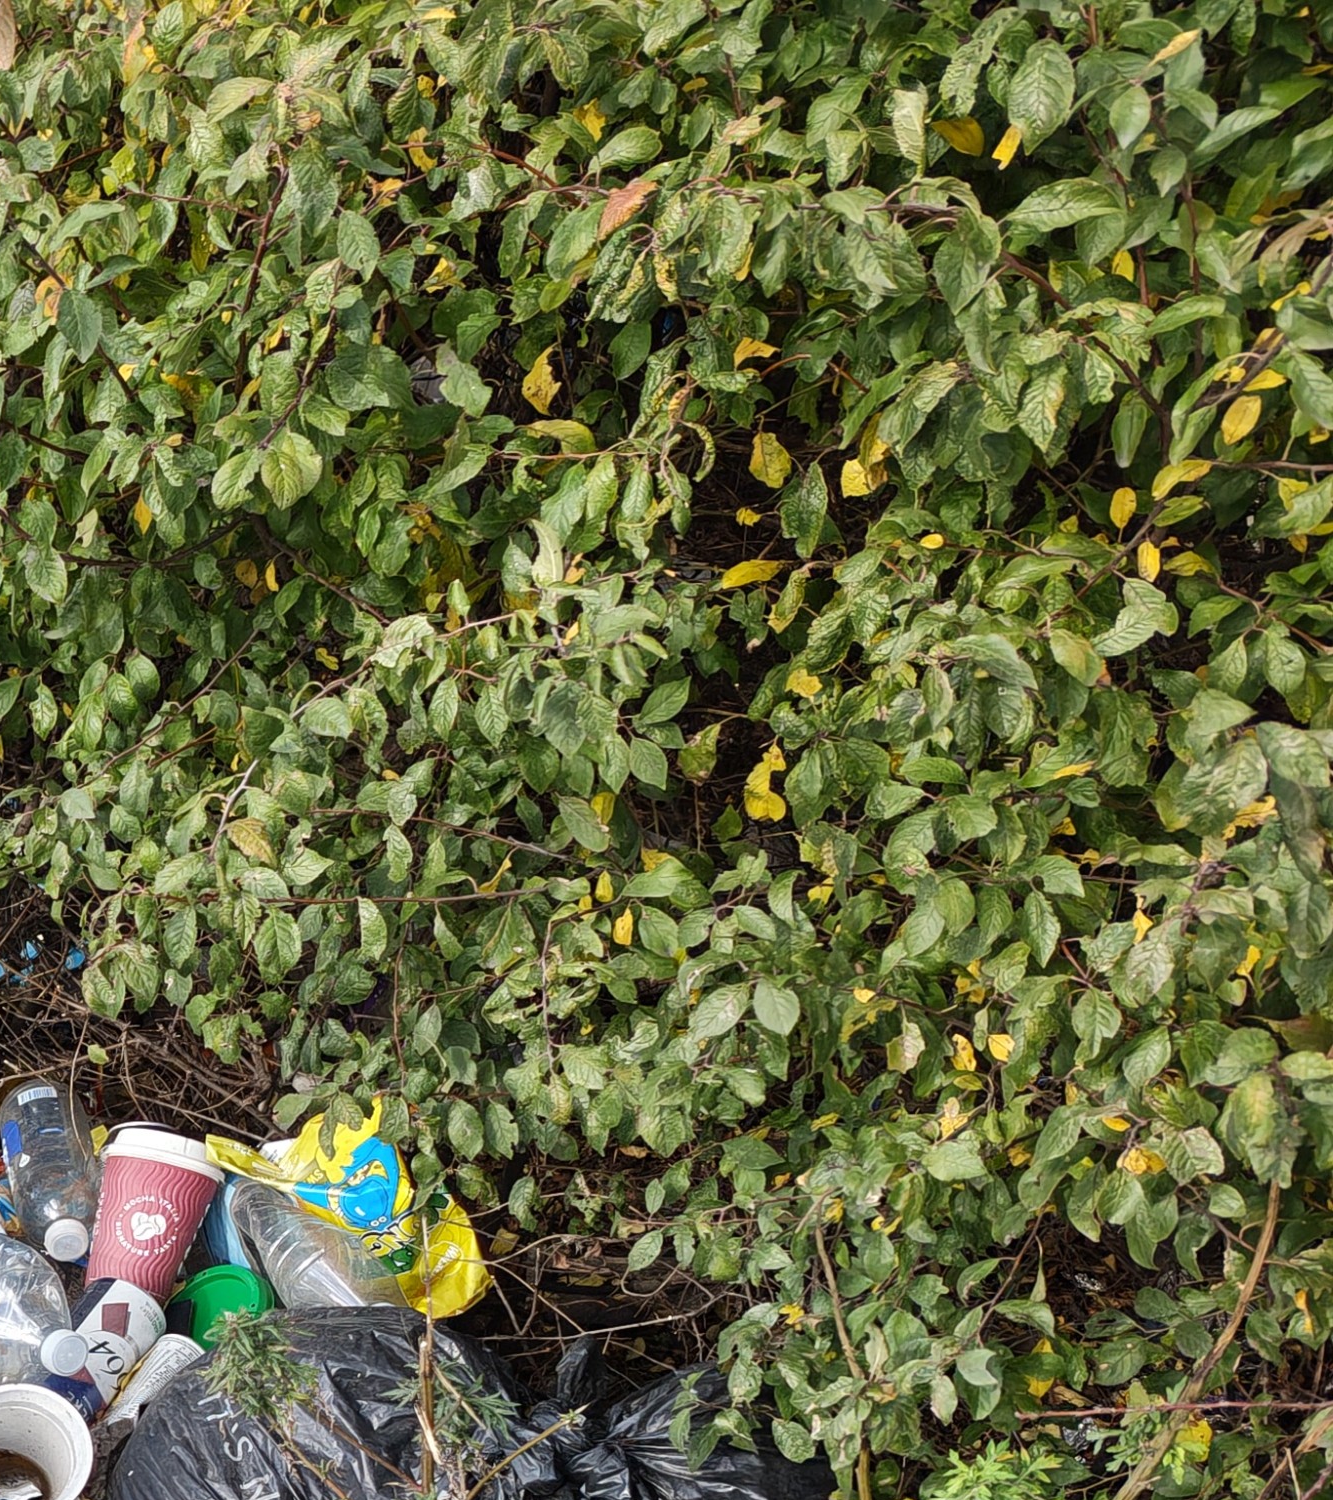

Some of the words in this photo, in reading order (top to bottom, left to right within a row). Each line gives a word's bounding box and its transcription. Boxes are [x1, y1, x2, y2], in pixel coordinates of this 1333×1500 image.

[123, 1194, 155, 1211] MOCHA
[159, 1196, 180, 1223] ITALIA
[115, 1221, 150, 1257] SIGNATURE
[153, 1234, 178, 1256] TASTE
